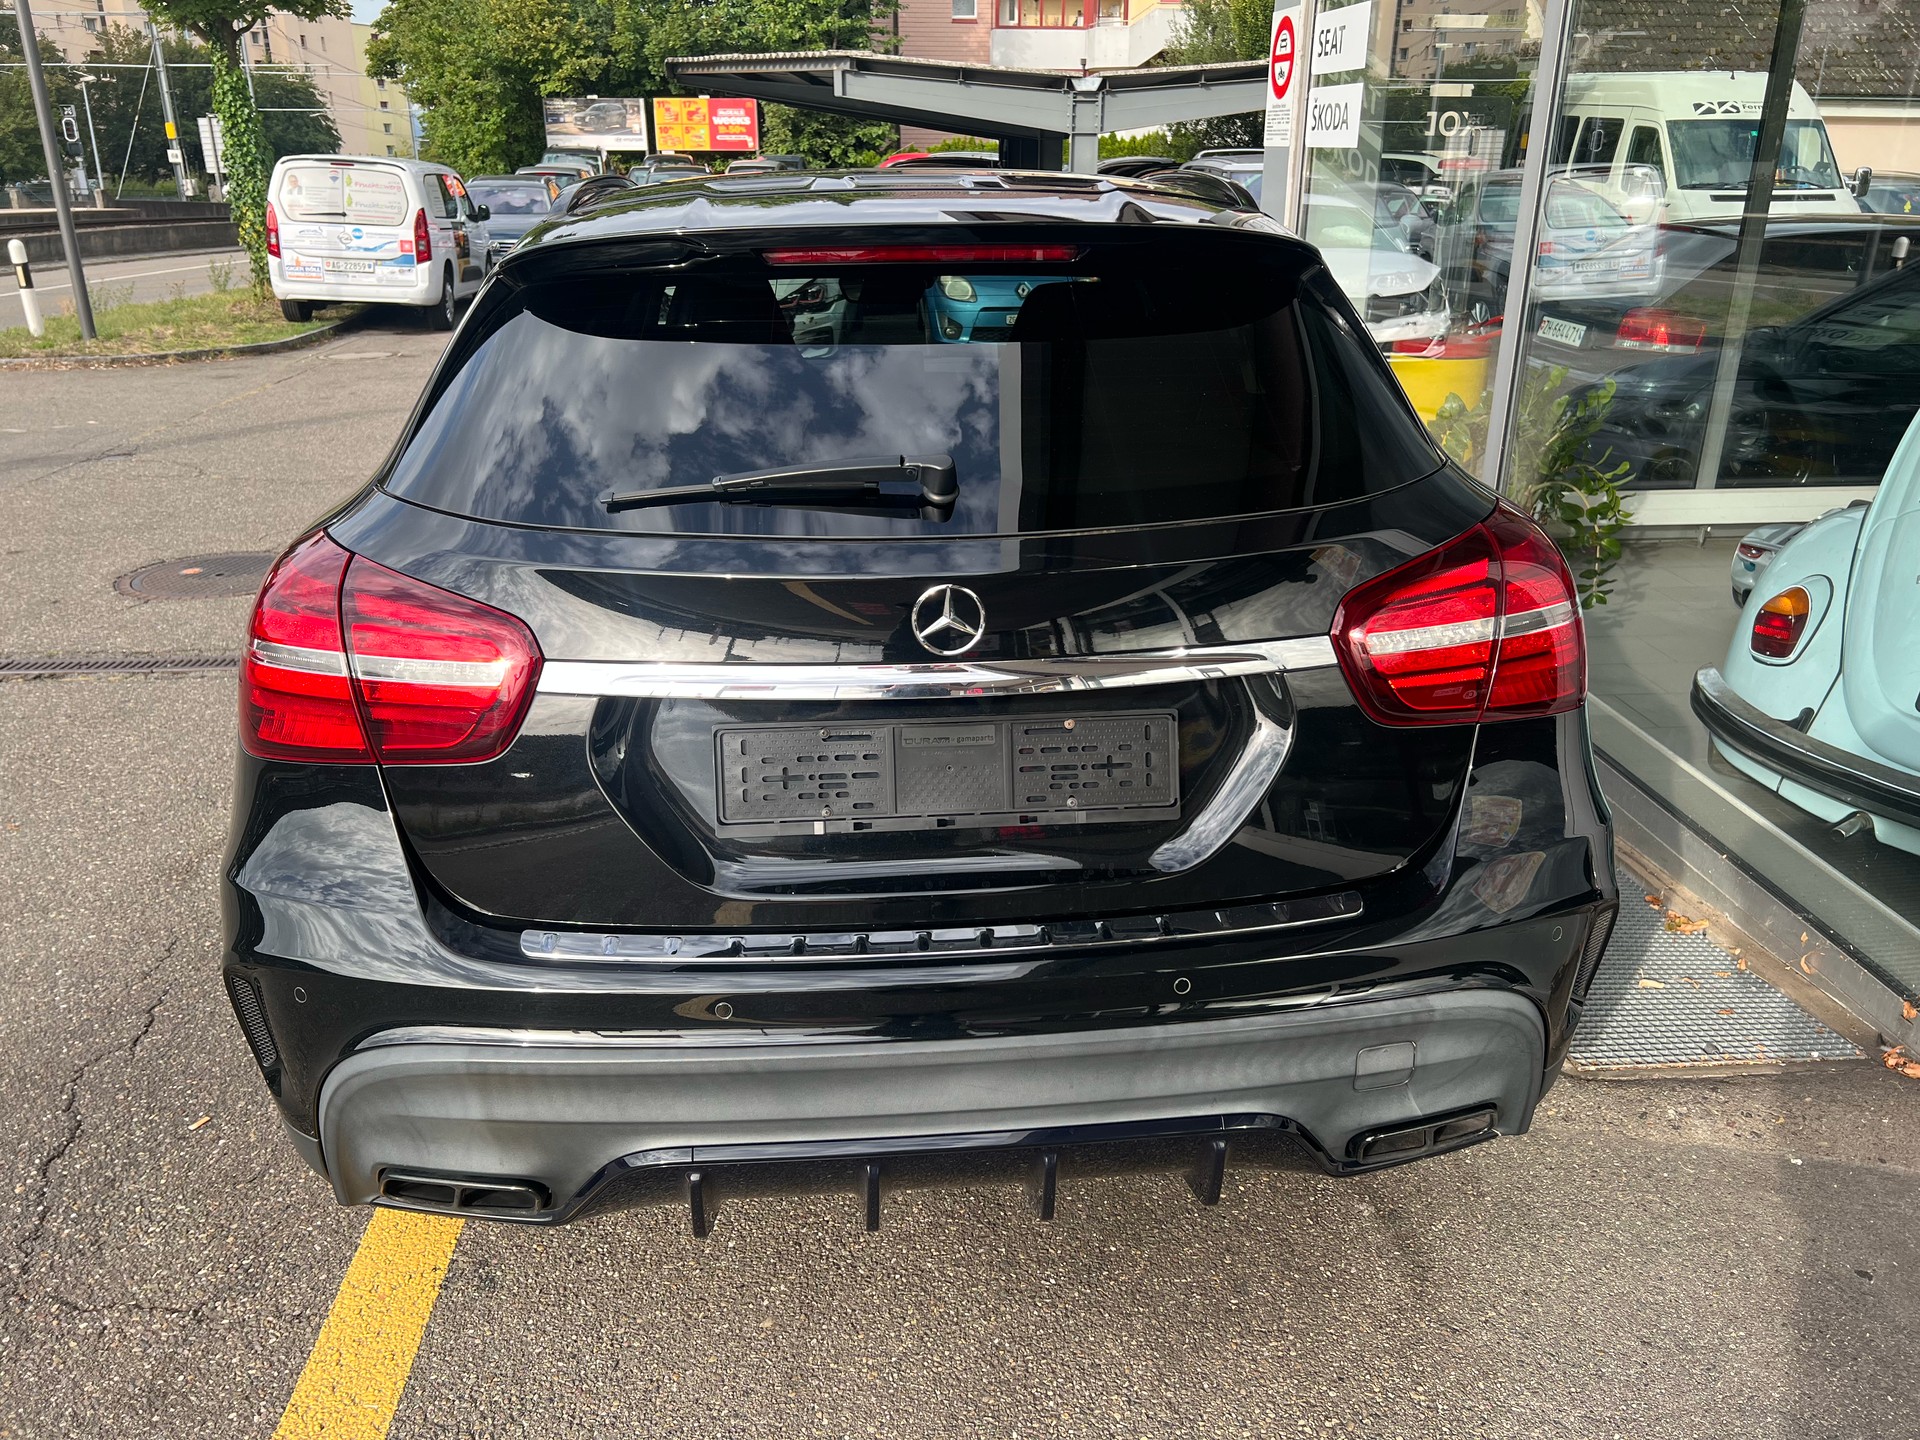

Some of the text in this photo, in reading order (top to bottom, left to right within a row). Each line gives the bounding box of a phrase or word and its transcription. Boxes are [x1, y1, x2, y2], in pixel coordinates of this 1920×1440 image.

[1317, 25, 1346, 57] SEAT
[1311, 97, 1349, 131] ŠKODA
[956, 734, 994, 743] gamaparts
